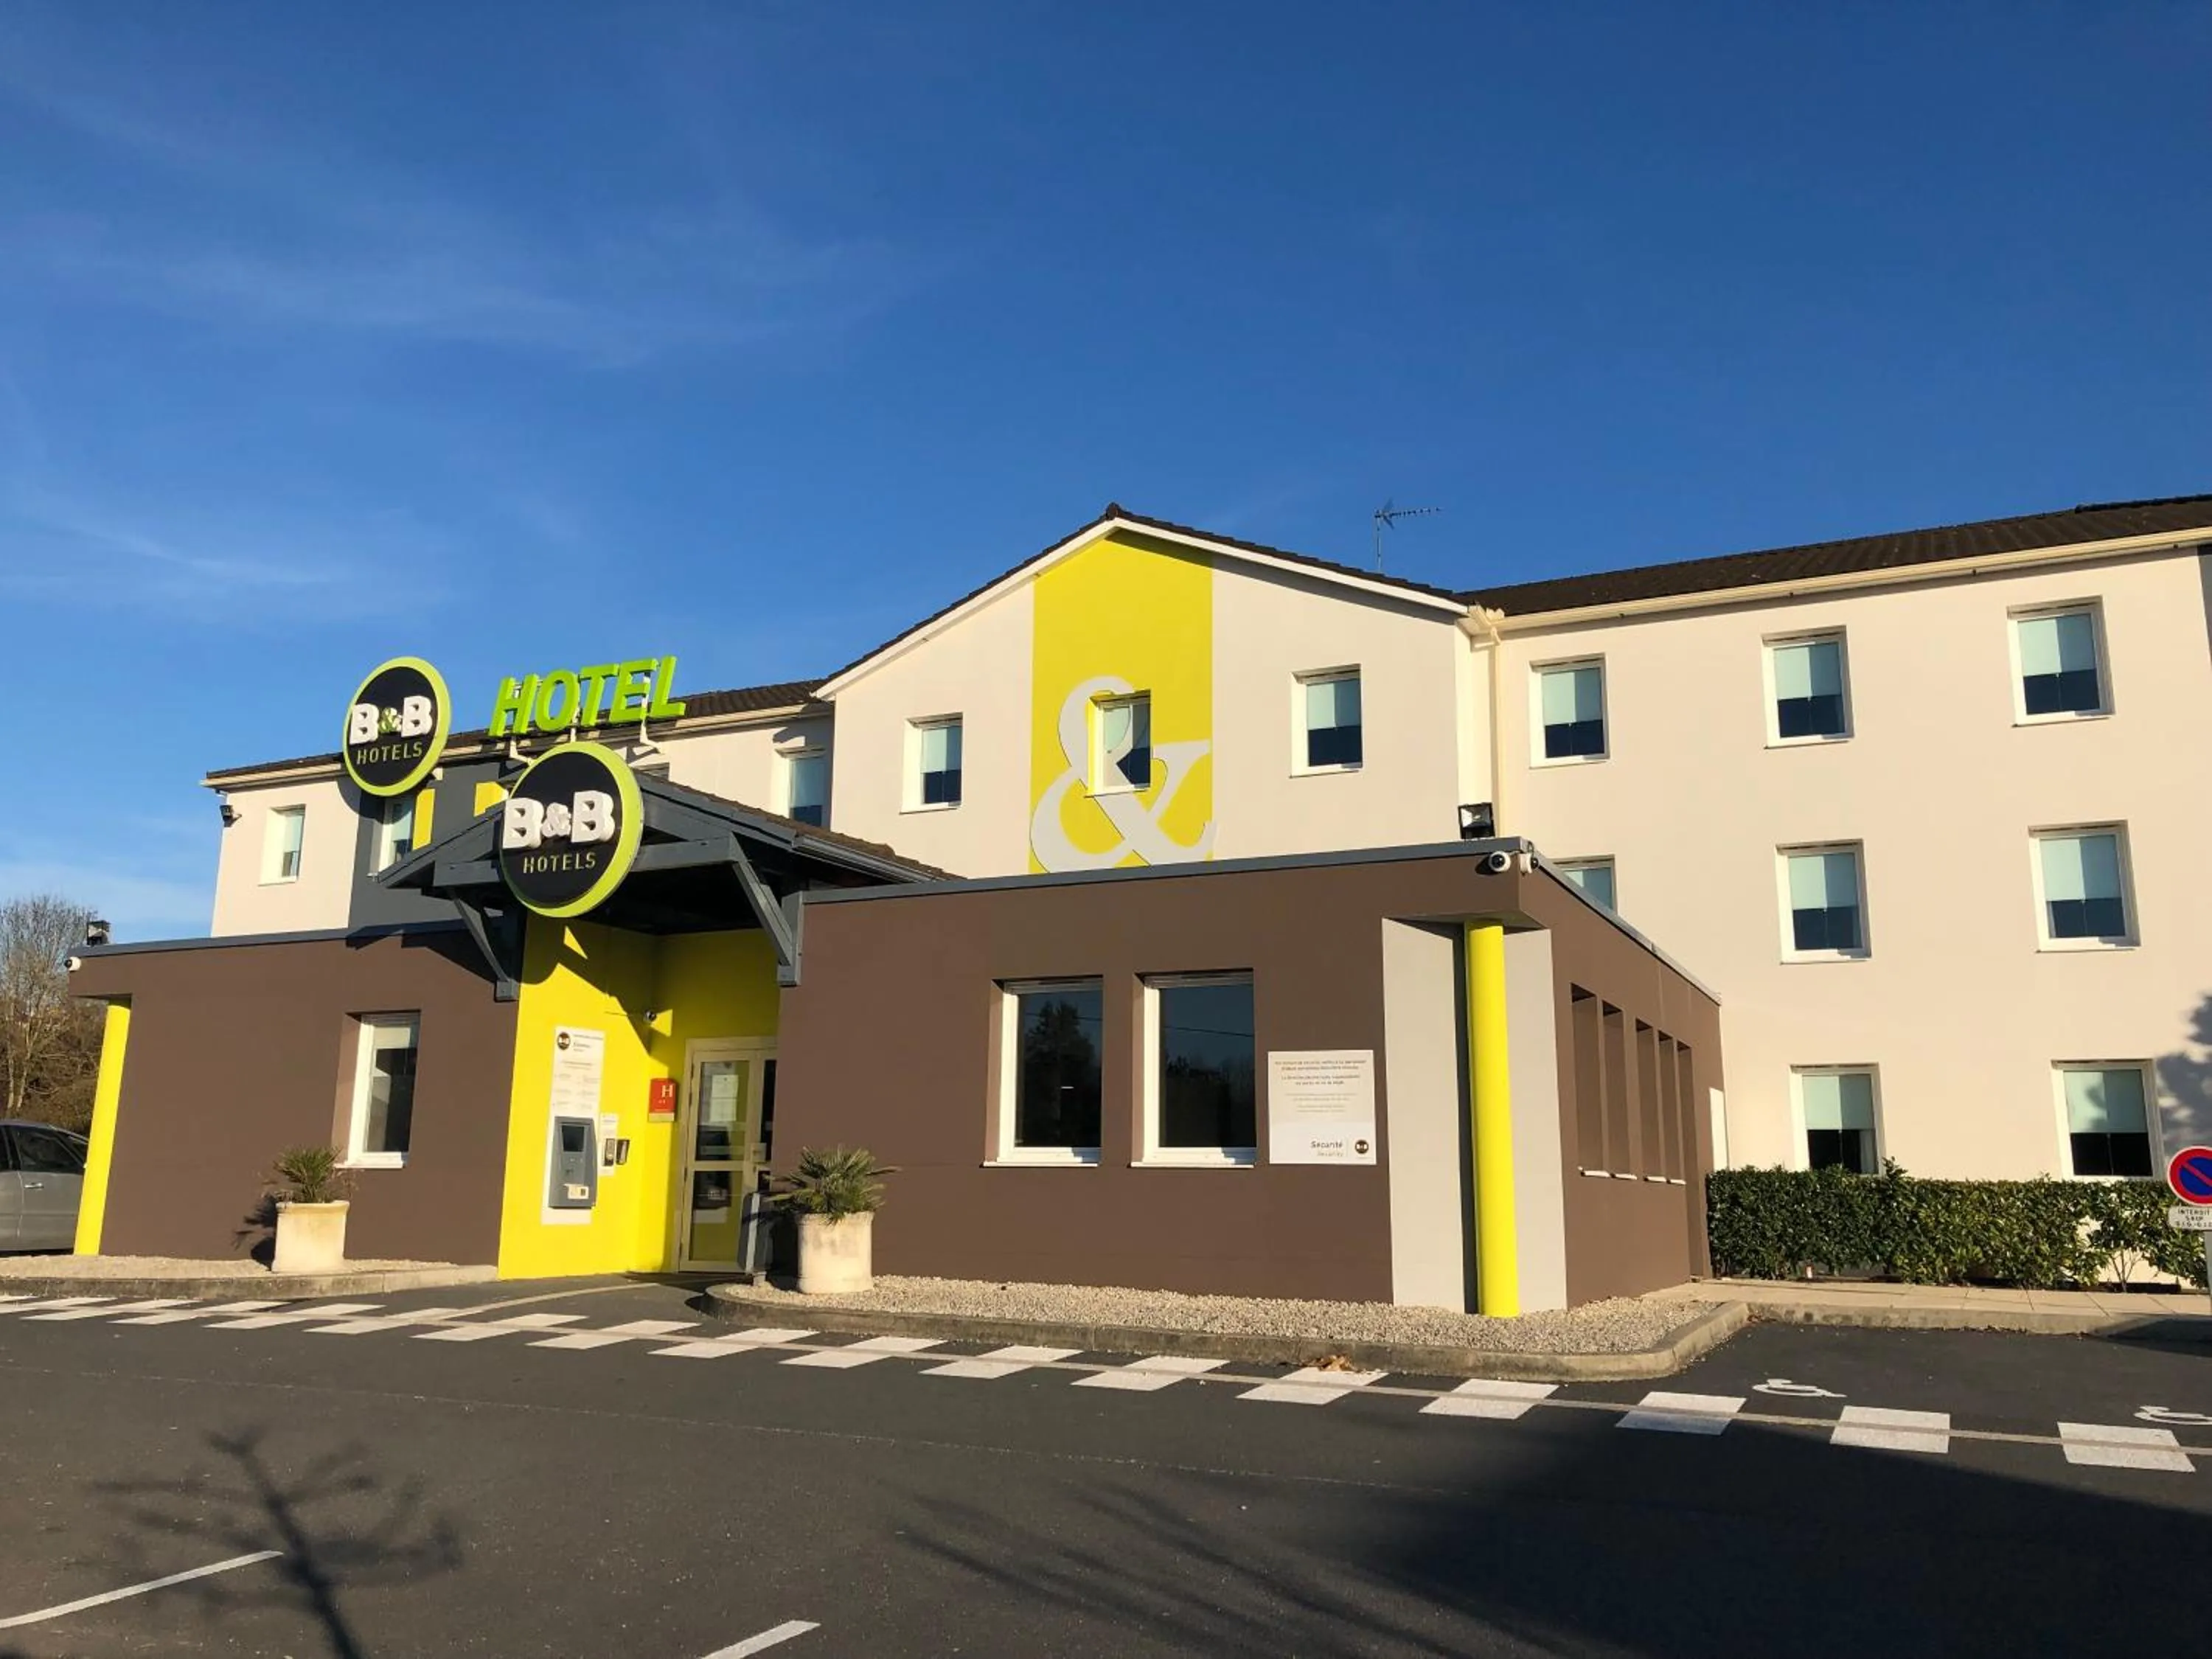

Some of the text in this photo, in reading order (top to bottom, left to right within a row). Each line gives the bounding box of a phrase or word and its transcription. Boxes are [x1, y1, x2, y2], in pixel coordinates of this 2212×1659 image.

[488, 655, 686, 737] HOTEL
[349, 695, 432, 745] B&B
[356, 740, 423, 765] HOTELS
[502, 790, 616, 850] B&B
[523, 852, 597, 874] HOTELS
[661, 1085, 673, 1098] H
